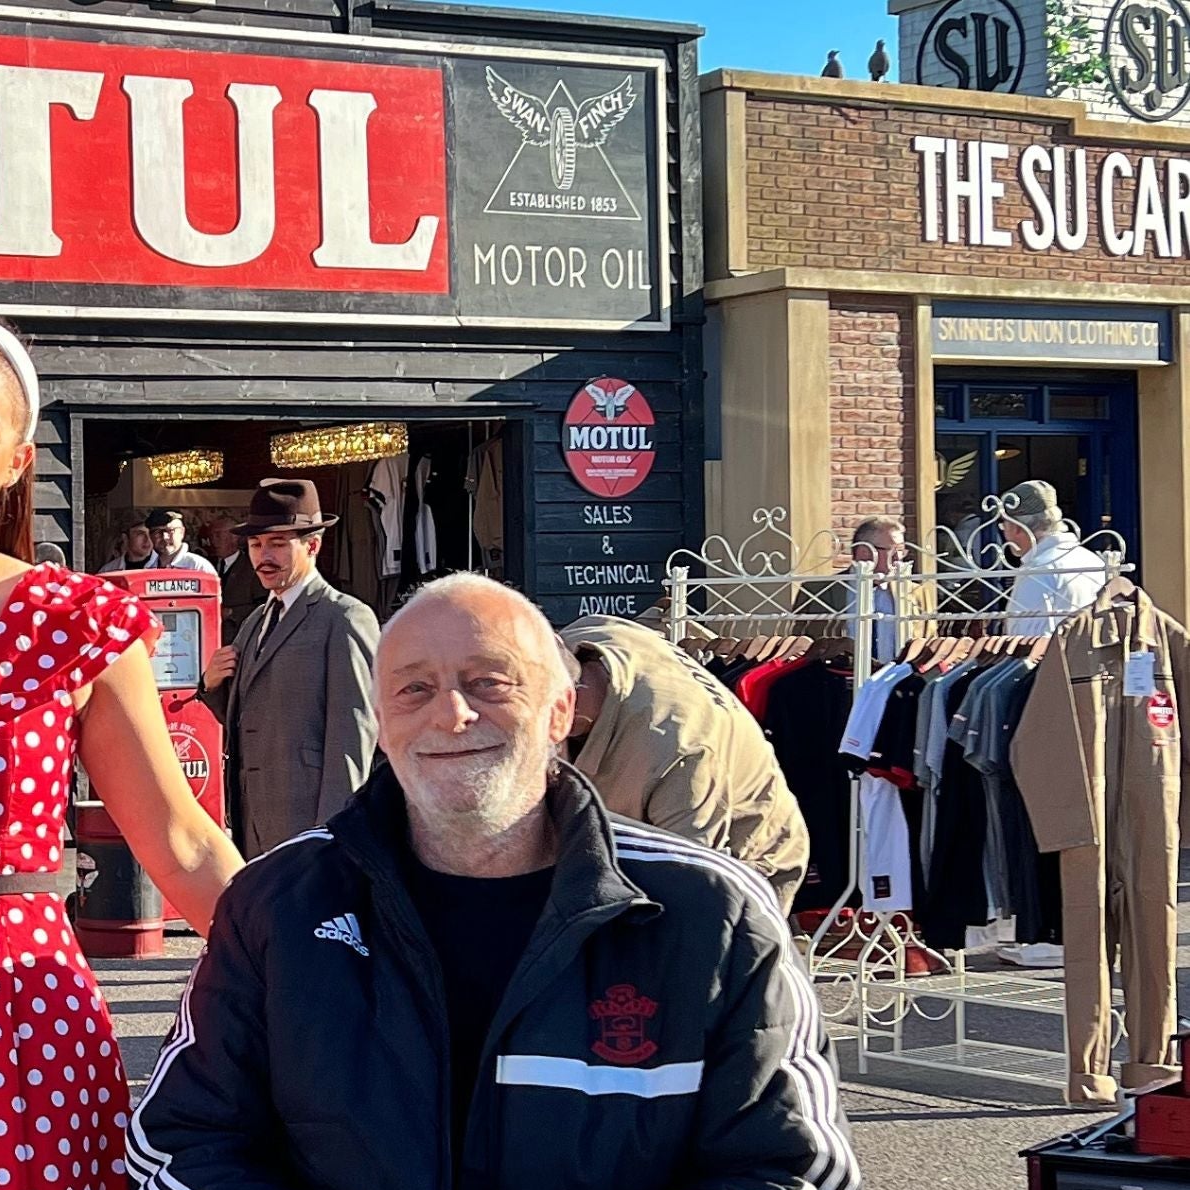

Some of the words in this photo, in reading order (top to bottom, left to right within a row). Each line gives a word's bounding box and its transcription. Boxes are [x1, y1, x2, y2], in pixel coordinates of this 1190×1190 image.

[934, 12, 1013, 93] SU
[578, 92, 624, 139] FINCH
[510, 192, 586, 211] ESTABLISHED
[590, 196, 618, 212] 1853
[913, 136, 1012, 246] THE
[1020, 145, 1087, 250] SU
[473, 243, 587, 289] MOTOR
[601, 248, 652, 290] OIL
[938, 317, 1014, 342] SKINNERS
[1018, 320, 1063, 344] UNION
[1067, 322, 1138, 346] CLOTHING
[569, 426, 654, 450] MOTUL
[584, 505, 633, 525] SALES
[602, 535, 615, 555] &
[564, 565, 655, 586] TECHNICAL
[578, 595, 637, 616] ADVICE
[314, 928, 370, 956] adidas
